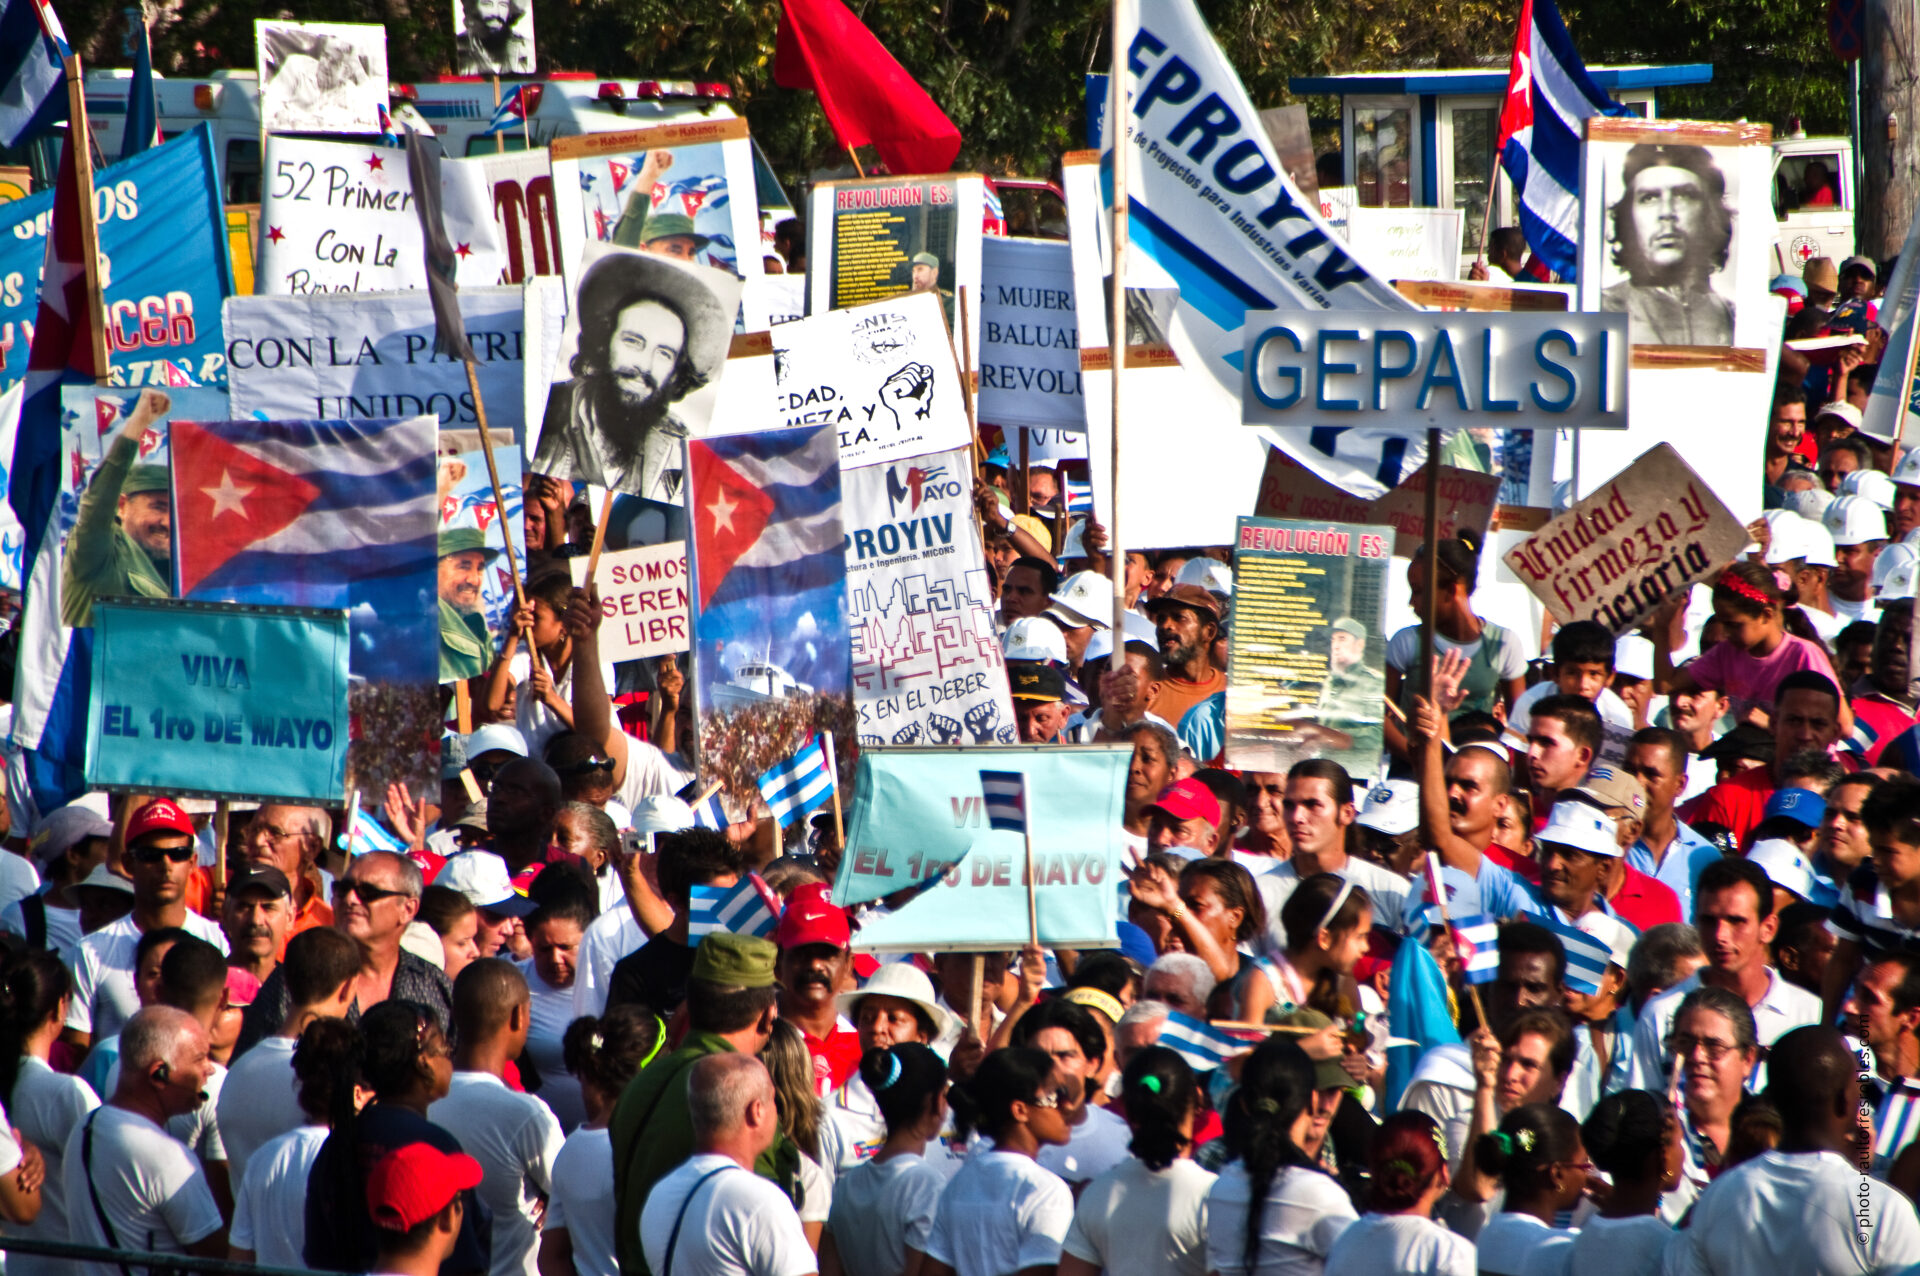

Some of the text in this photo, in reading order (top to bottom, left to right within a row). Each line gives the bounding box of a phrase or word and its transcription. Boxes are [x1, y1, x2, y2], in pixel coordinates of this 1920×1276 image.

[272, 160, 415, 212] 52 Primer
[836, 183, 954, 211] REVOLUCIÓN ES:
[1197, 183, 1233, 217] para
[1292, 263, 1333, 312] Varias
[998, 285, 1077, 312] MUJER
[228, 337, 313, 369] CON
[326, 335, 383, 366] LA
[1251, 326, 1613, 414] GEPALSI
[315, 392, 479, 424] UNIDOS
[1240, 527, 1389, 559] REVOLUCIÓN ES:
[181, 654, 251, 690] VIVA
[876, 696, 900, 720] EN
[906, 689, 927, 711] EL
[929, 672, 992, 705] DEBER
[103, 705, 334, 751] EL 1ro DE MAYO
[853, 846, 895, 877] EL
[971, 854, 1013, 887] DE
[1022, 853, 1108, 886] MAYO
